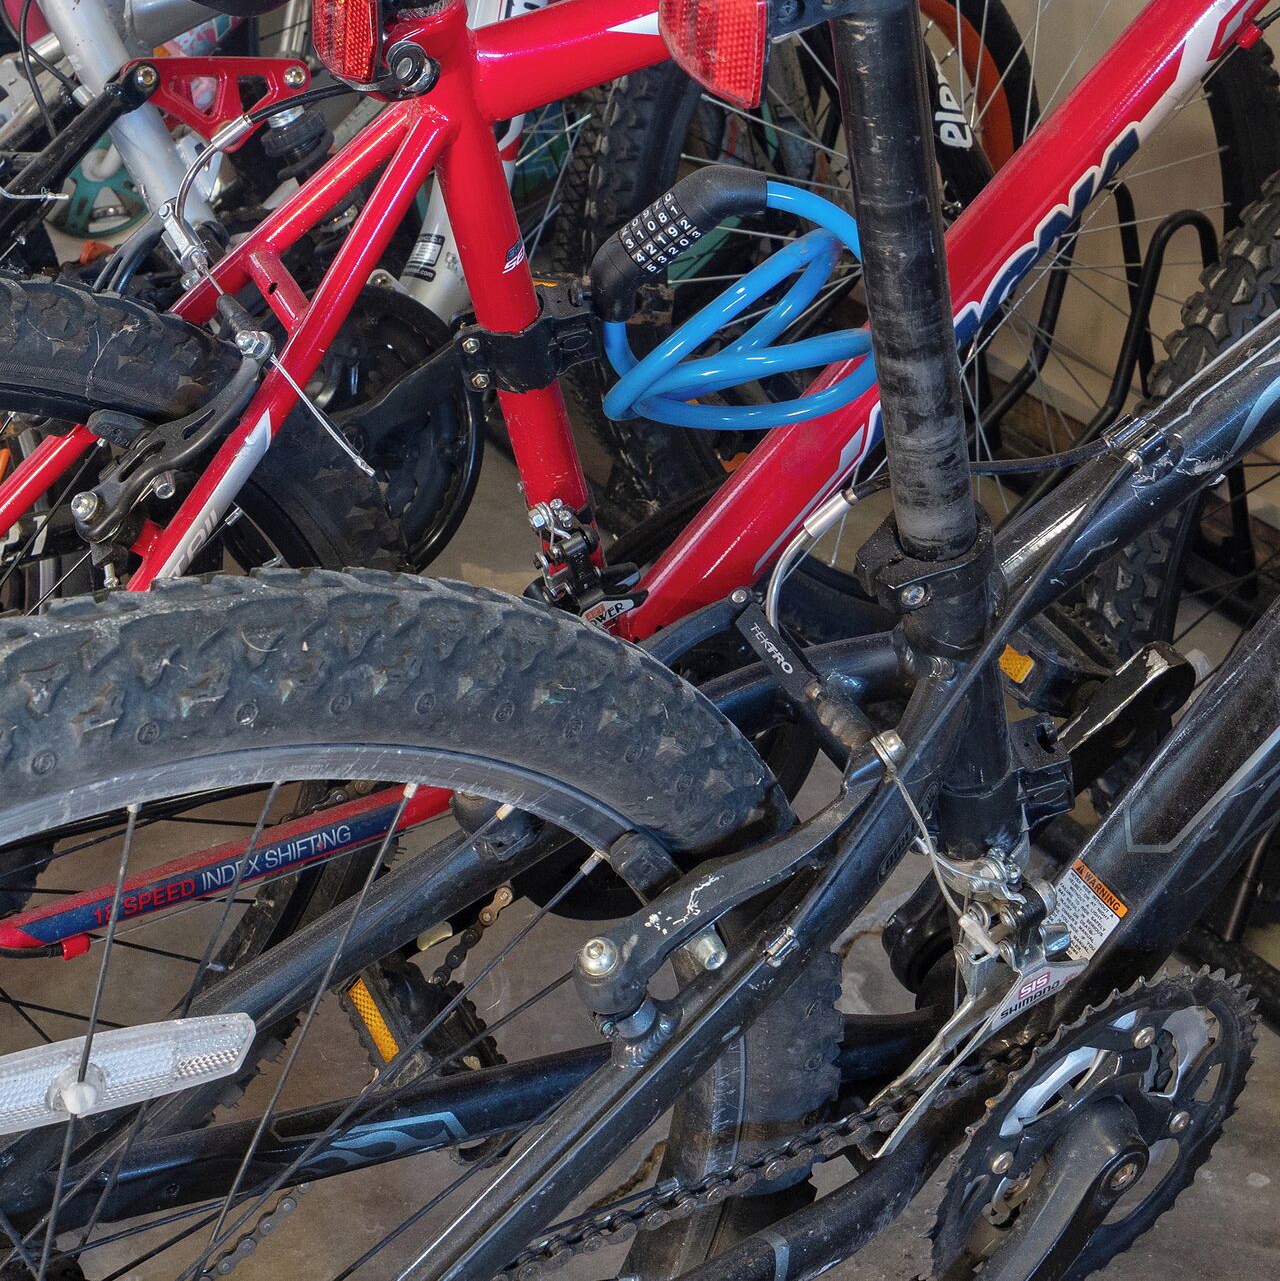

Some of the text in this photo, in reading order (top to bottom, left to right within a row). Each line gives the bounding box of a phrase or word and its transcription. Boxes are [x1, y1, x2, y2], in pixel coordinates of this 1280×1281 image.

[751, 622, 794, 675] TEKTRO
[123, 878, 197, 917] SPEED
[201, 858, 260, 891] INDEX
[264, 824, 352, 869] SHIFTING
[1082, 871, 1121, 911] WARNING
[1001, 980, 1060, 1019] SHIMANO
[1020, 974, 1048, 998] SIS
